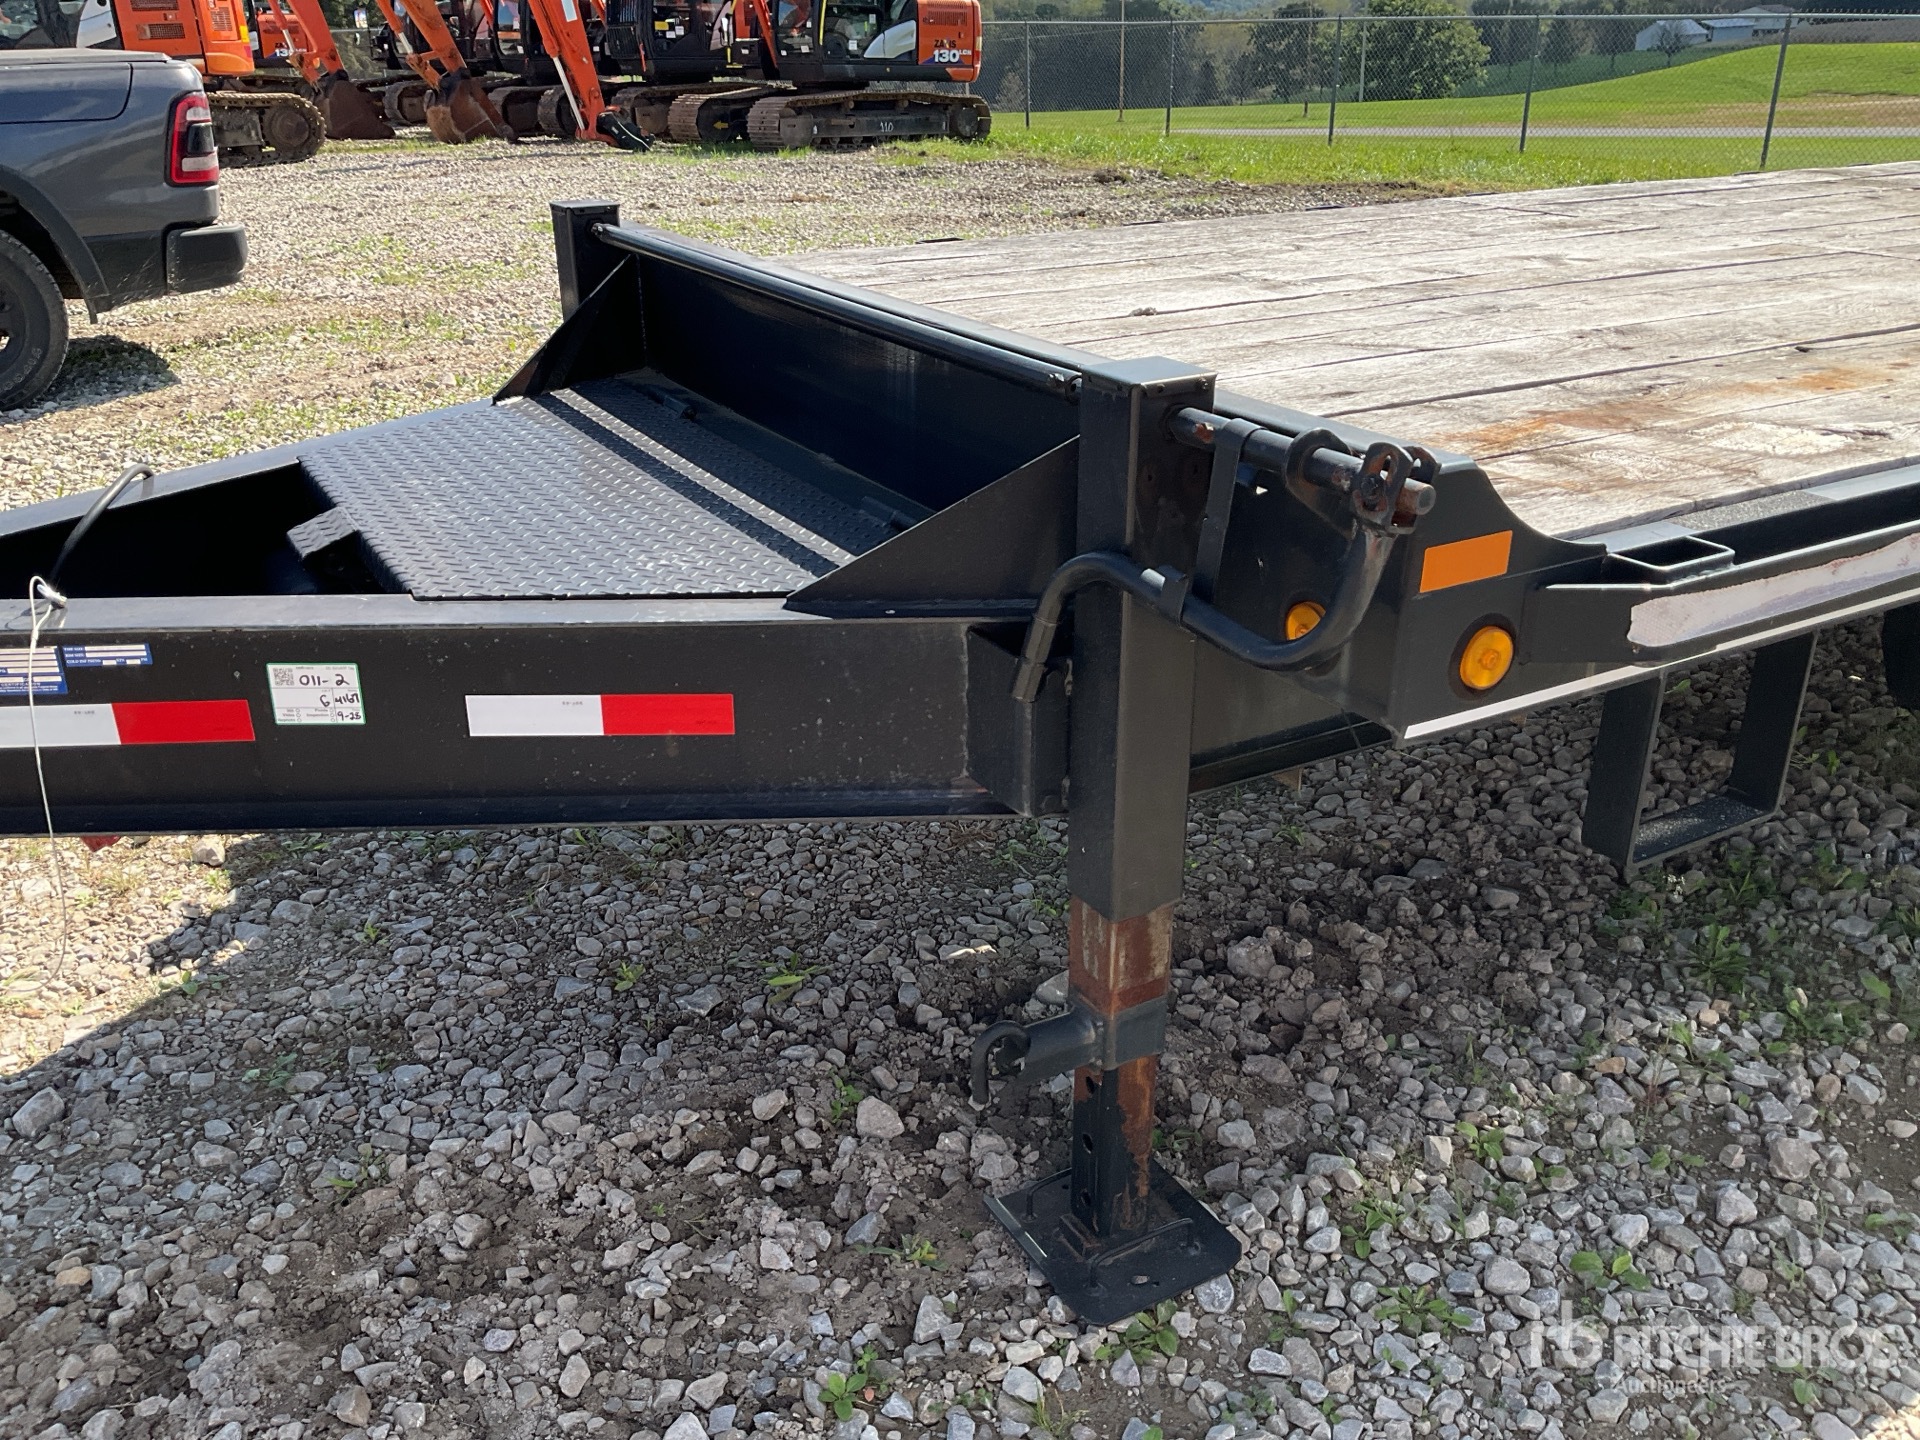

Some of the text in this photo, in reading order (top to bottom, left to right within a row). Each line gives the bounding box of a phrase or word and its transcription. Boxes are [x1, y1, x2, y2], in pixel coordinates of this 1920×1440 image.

[933, 49, 960, 63] 130
[879, 121, 894, 132] 110
[335, 673, 350, 686] 2
